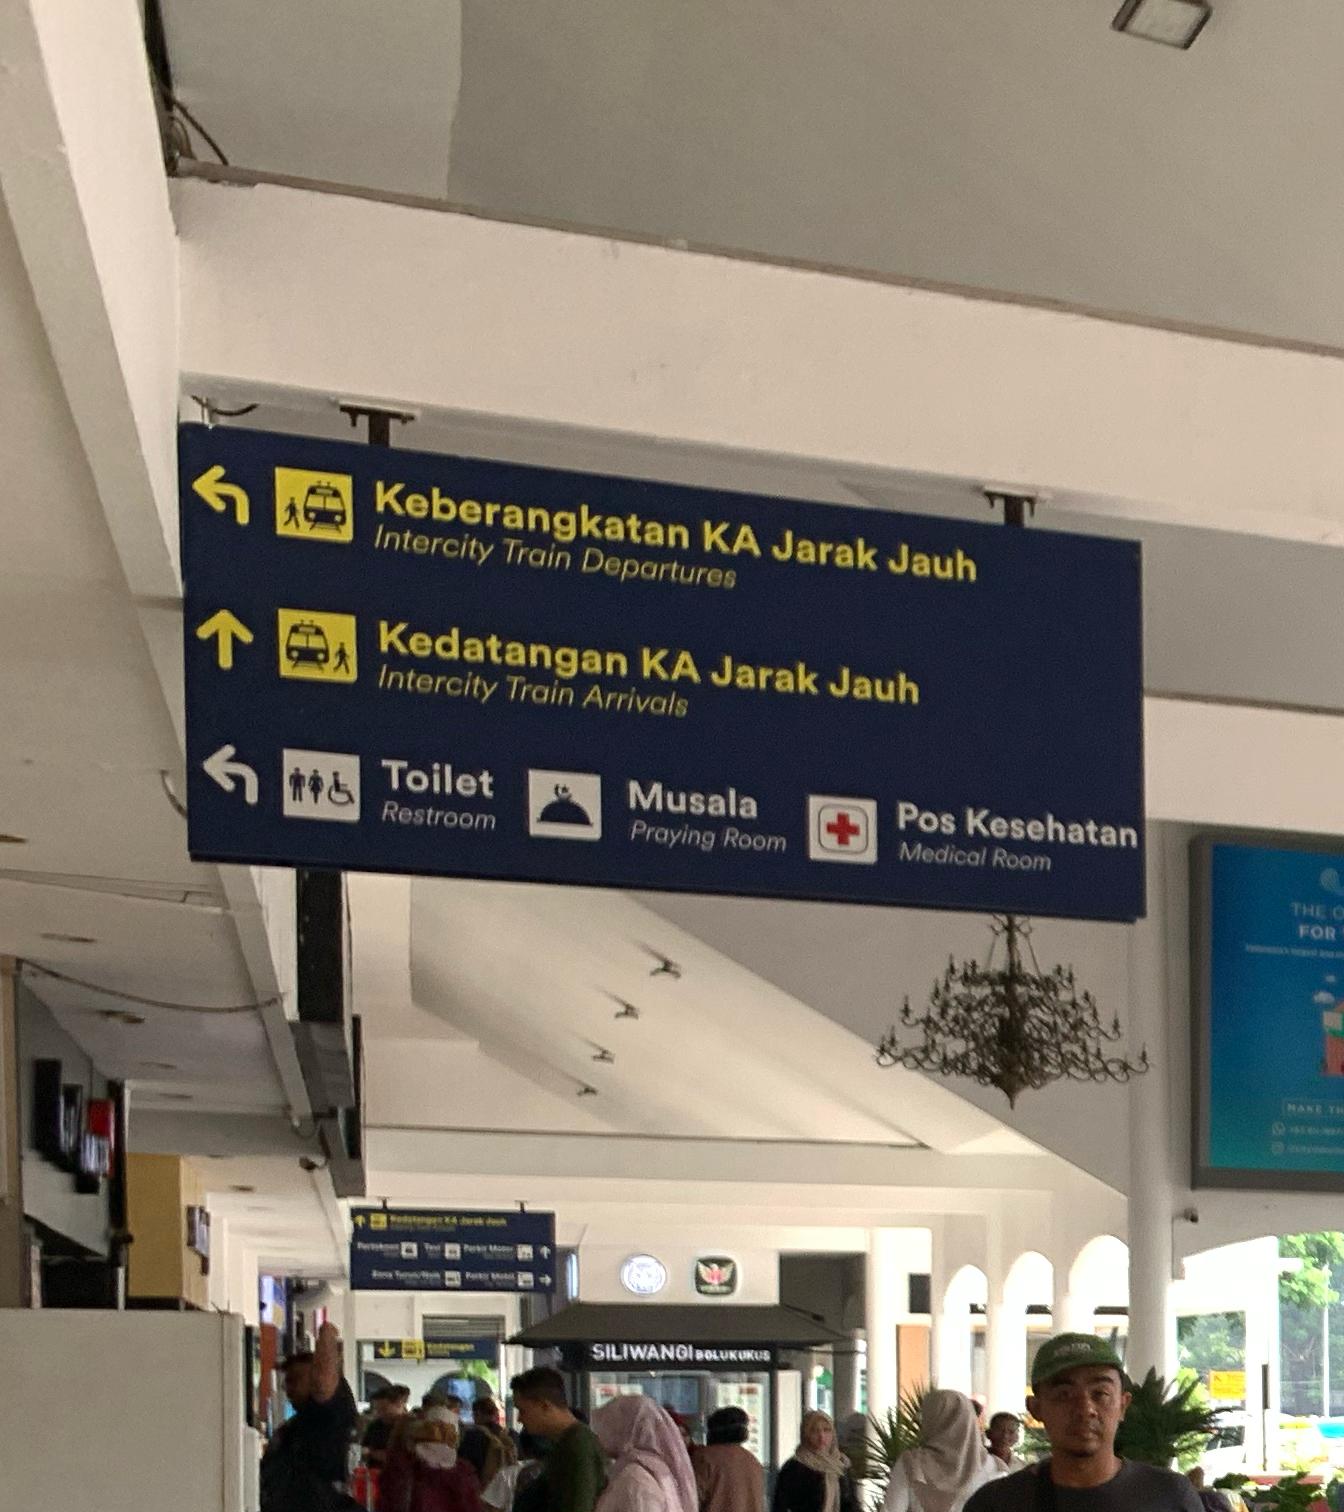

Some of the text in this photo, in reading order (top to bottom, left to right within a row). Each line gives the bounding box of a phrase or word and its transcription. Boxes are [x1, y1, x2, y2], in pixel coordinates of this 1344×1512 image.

[375, 480, 978, 583] Keberangkatan KA Jarak Jauh
[374, 523, 738, 589] Intercity Train Departures
[379, 620, 919, 705] Kedatangan KA Jarak Jauh
[378, 663, 689, 718] Intercity Train Arrivals
[381, 759, 494, 799] Toilet
[382, 801, 496, 831] Restroom
[628, 779, 758, 819] Musala
[631, 820, 787, 853] Praying Room
[898, 801, 1138, 848] Pos Kesehatan
[899, 841, 1051, 871] Medical Room
[1291, 901, 1326, 918] THE
[1299, 924, 1336, 942] FOR
[1287, 1102, 1322, 1115] MAKE
[591, 1343, 694, 1361] SILIWANGI
